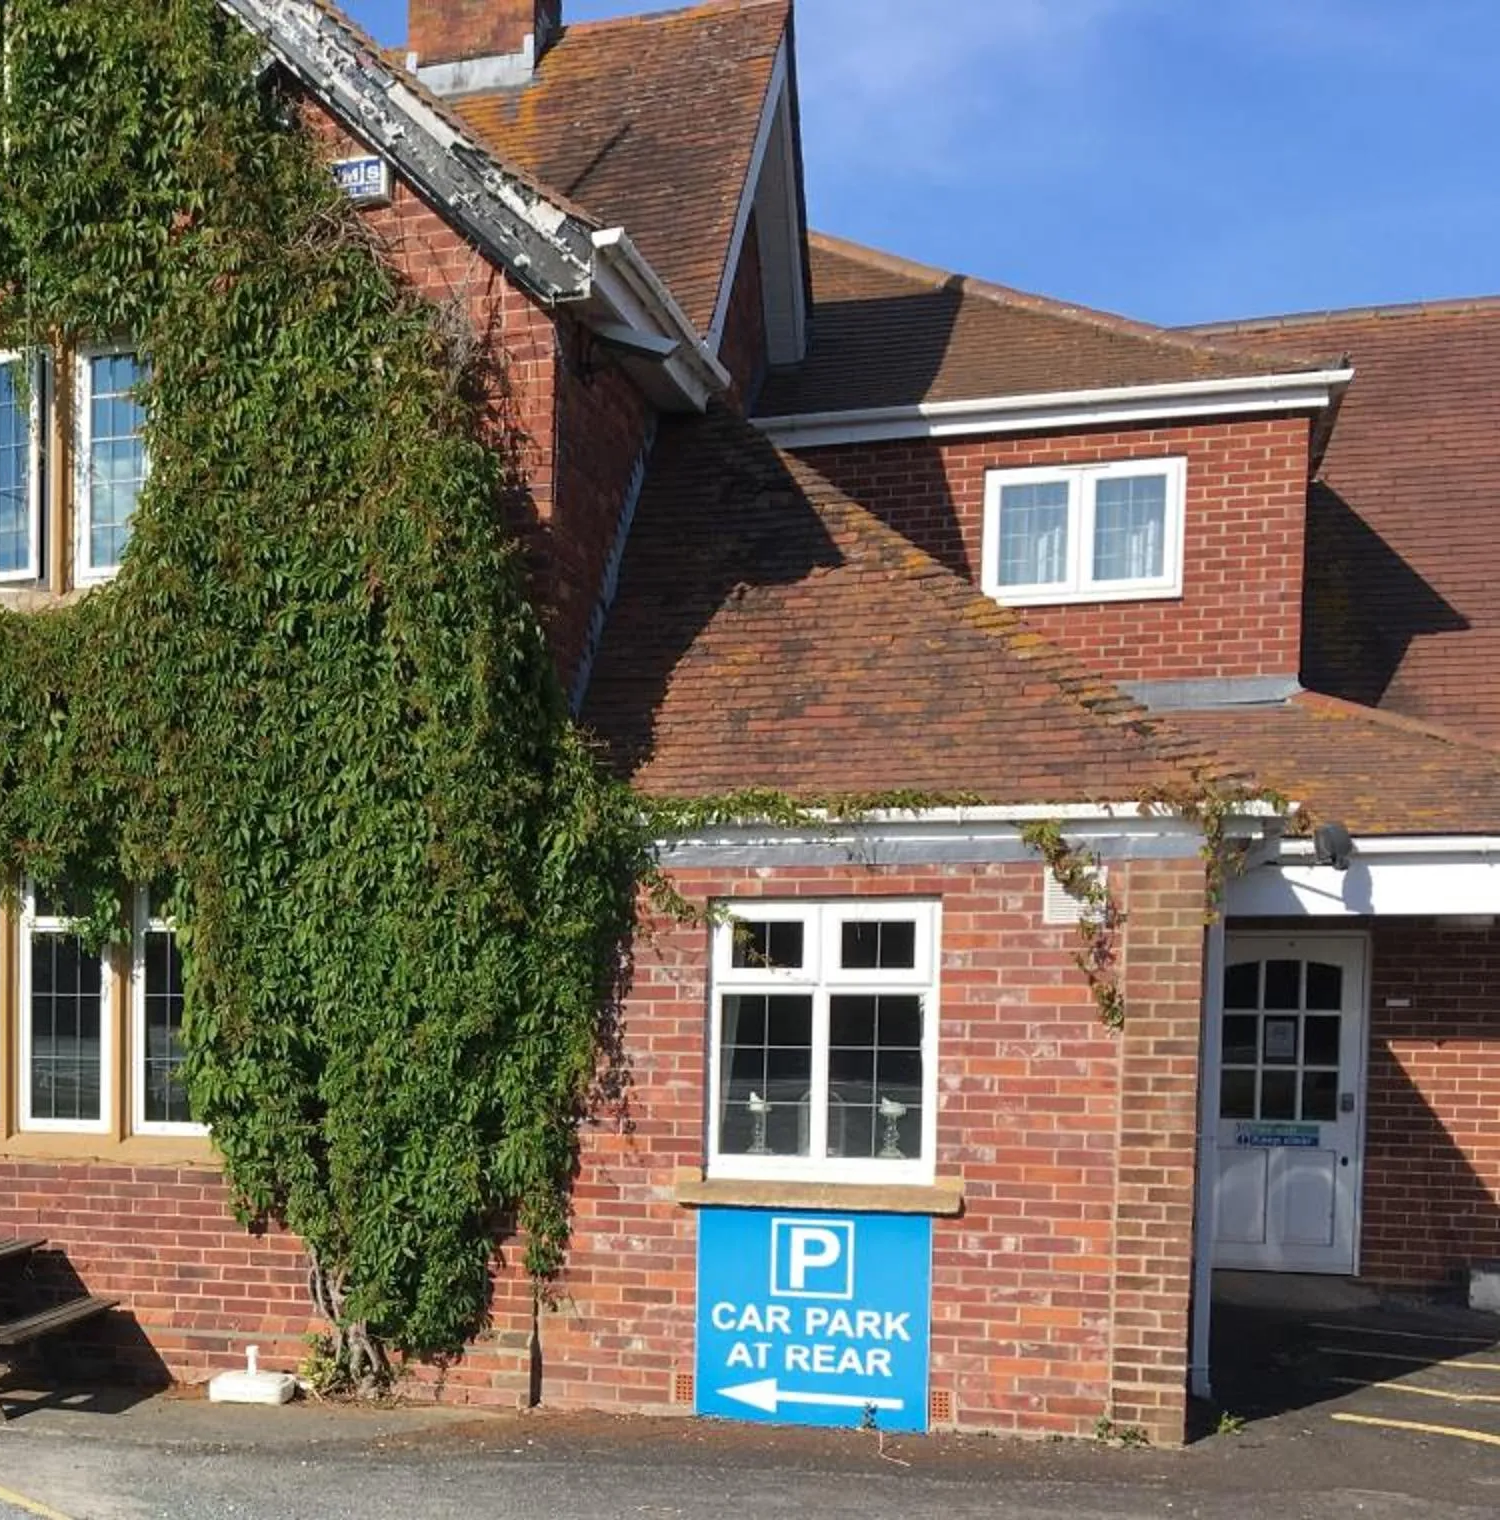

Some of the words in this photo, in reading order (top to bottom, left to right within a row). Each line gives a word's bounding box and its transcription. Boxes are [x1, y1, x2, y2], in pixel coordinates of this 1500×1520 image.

[789, 1227, 841, 1289] P
[711, 1302, 792, 1335] CAR
[805, 1307, 911, 1342] PARK
[726, 1341, 773, 1369] AT
[785, 1344, 892, 1377] REAR
